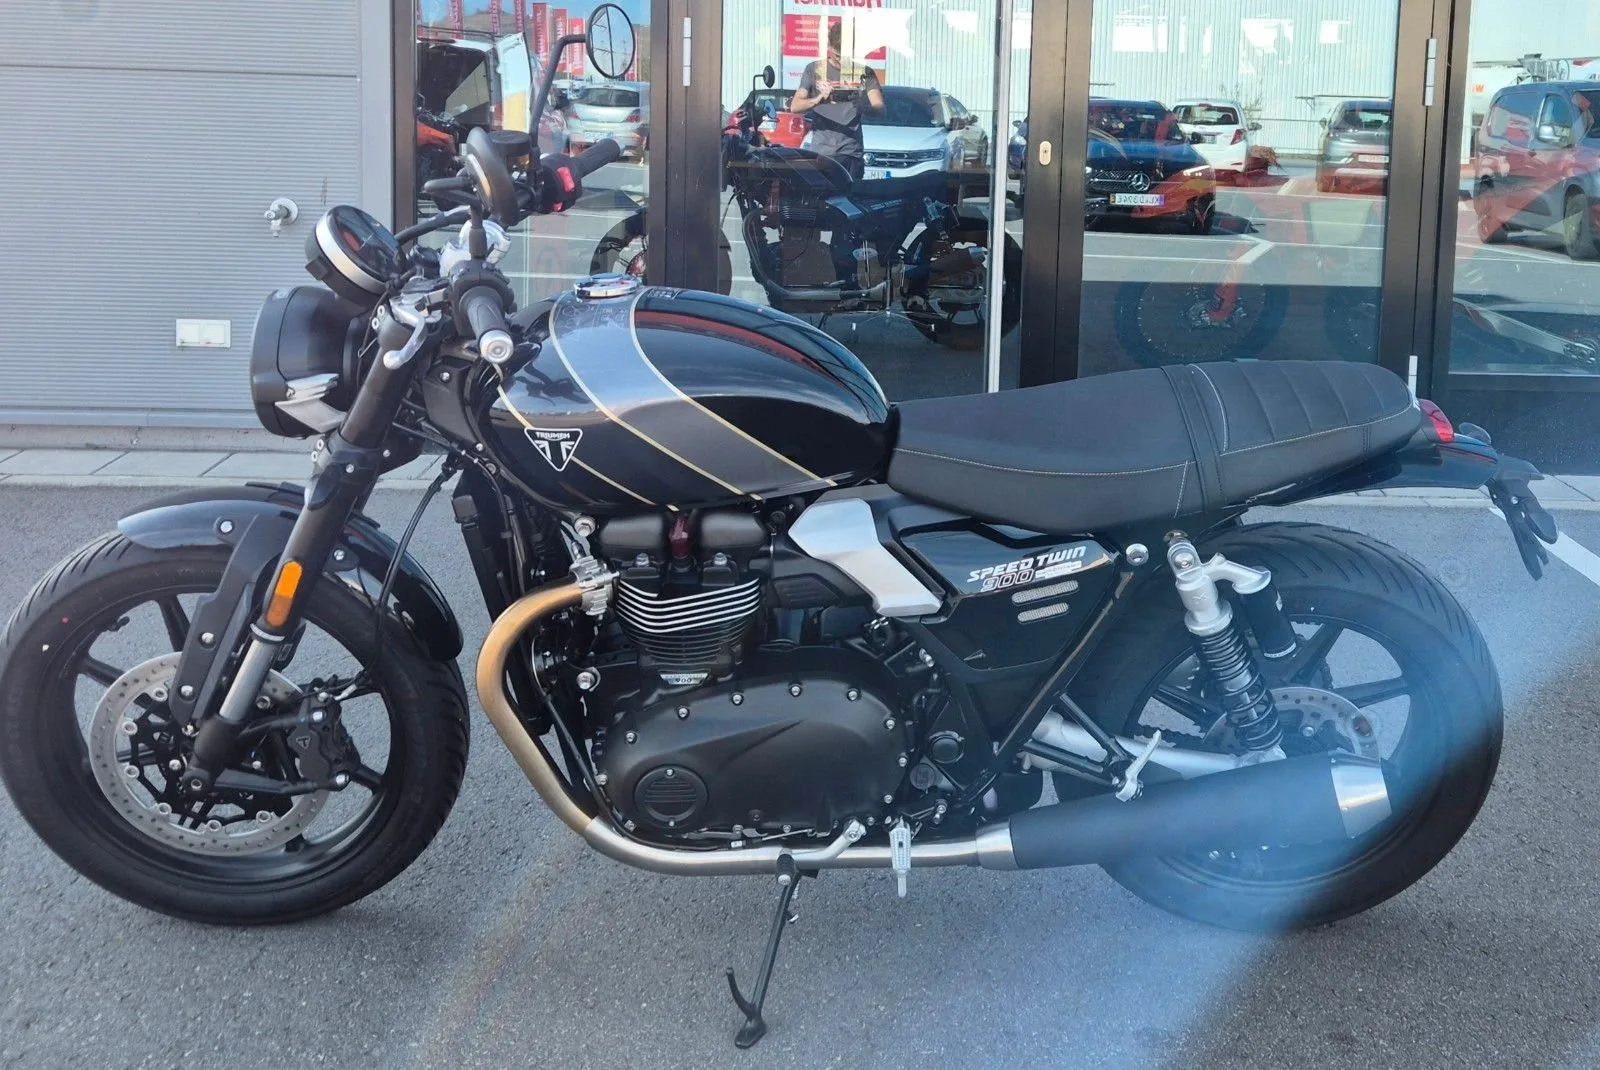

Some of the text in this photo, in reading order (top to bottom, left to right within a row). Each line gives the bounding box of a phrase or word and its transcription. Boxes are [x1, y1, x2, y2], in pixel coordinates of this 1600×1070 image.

[535, 431, 570, 441] TRIUMPH
[967, 558, 1034, 583] SPEED
[1035, 546, 1087, 567] TWIN
[980, 568, 1035, 593] 900
